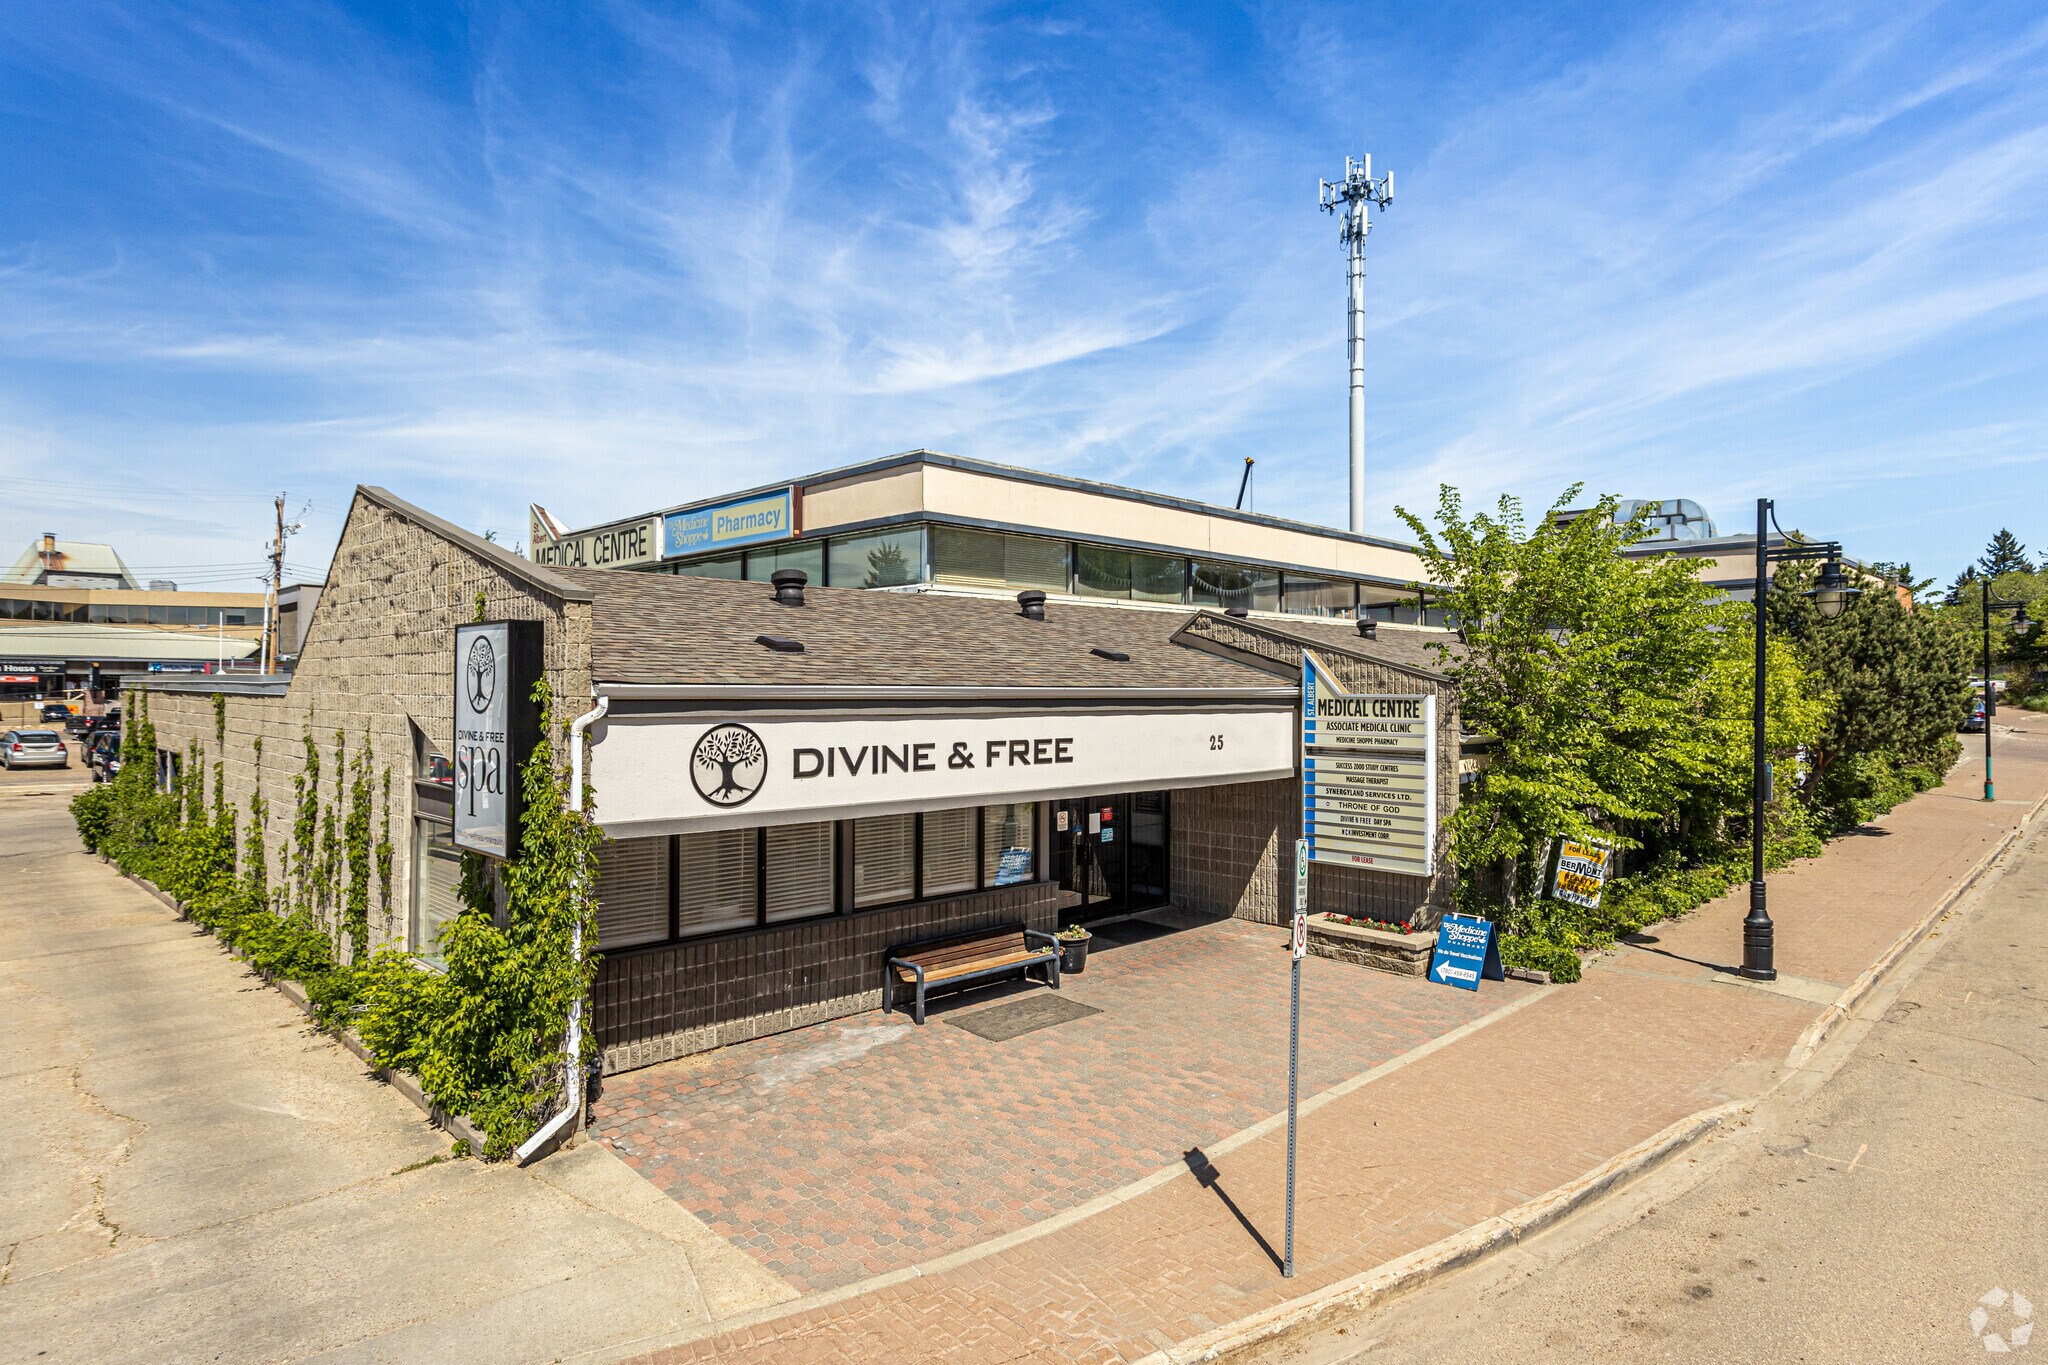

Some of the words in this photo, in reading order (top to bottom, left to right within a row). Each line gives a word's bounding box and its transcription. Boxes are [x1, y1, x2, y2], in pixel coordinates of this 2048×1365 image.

[671, 514, 709, 538] Medicine
[717, 509, 781, 534] Pharmacy
[532, 533, 547, 544] Albert
[674, 528, 703, 548] Shoppe
[536, 539, 588, 567] MEDICAL
[593, 525, 648, 565] CENTRE
[3, 664, 37, 672] House
[1307, 681, 1315, 705] ALBERT
[1307, 706, 1315, 716] ST.
[1318, 698, 1369, 717] MEDICAL
[1372, 699, 1420, 719] CENTRE
[1326, 721, 1359, 732] ASSOCIATE
[1360, 723, 1388, 733] MEDICAL
[1389, 723, 1412, 733] CLINIC
[458, 730, 478, 742] DIVINE
[478, 731, 485, 742] &
[485, 732, 504, 743] FREE
[1209, 734, 1225, 751] 25
[1336, 736, 1356, 744] MEDICINE
[1356, 737, 1373, 745] SHOPPE
[1374, 738, 1399, 746] PHARMACY
[792, 742, 936, 780] DIVINE
[947, 741, 975, 770] &
[986, 737, 1074, 768] FREE
[1335, 762, 1353, 770] SUCCESS
[1353, 763, 1365, 771] 2000
[1365, 764, 1379, 772] STUDY
[1379, 765, 1399, 773] CENTRES
[457, 744, 504, 818] spa
[1345, 776, 1365, 784] MASSAGE
[1365, 777, 1389, 786] THERAPIST
[1325, 787, 1364, 797] SYNERGYLAND
[1365, 791, 1396, 800] SERVICES
[1338, 802, 1368, 811] THRONE
[1370, 804, 1380, 812] OF
[1383, 805, 1400, 814] GOD
[1340, 815, 1355, 823] DIVINE
[1382, 819, 1392, 827] SPA
[1352, 830, 1377, 839] INVESTMENT
[1568, 845, 1580, 854] FOR
[1351, 855, 1360, 863] FOR
[1360, 857, 1374, 865] LEASE
[1561, 860, 1603, 876] BERMONT
[1446, 923, 1488, 937] Medicine
[1448, 931, 1480, 943] Shoppe
[1447, 940, 1485, 950] PHARMACY
